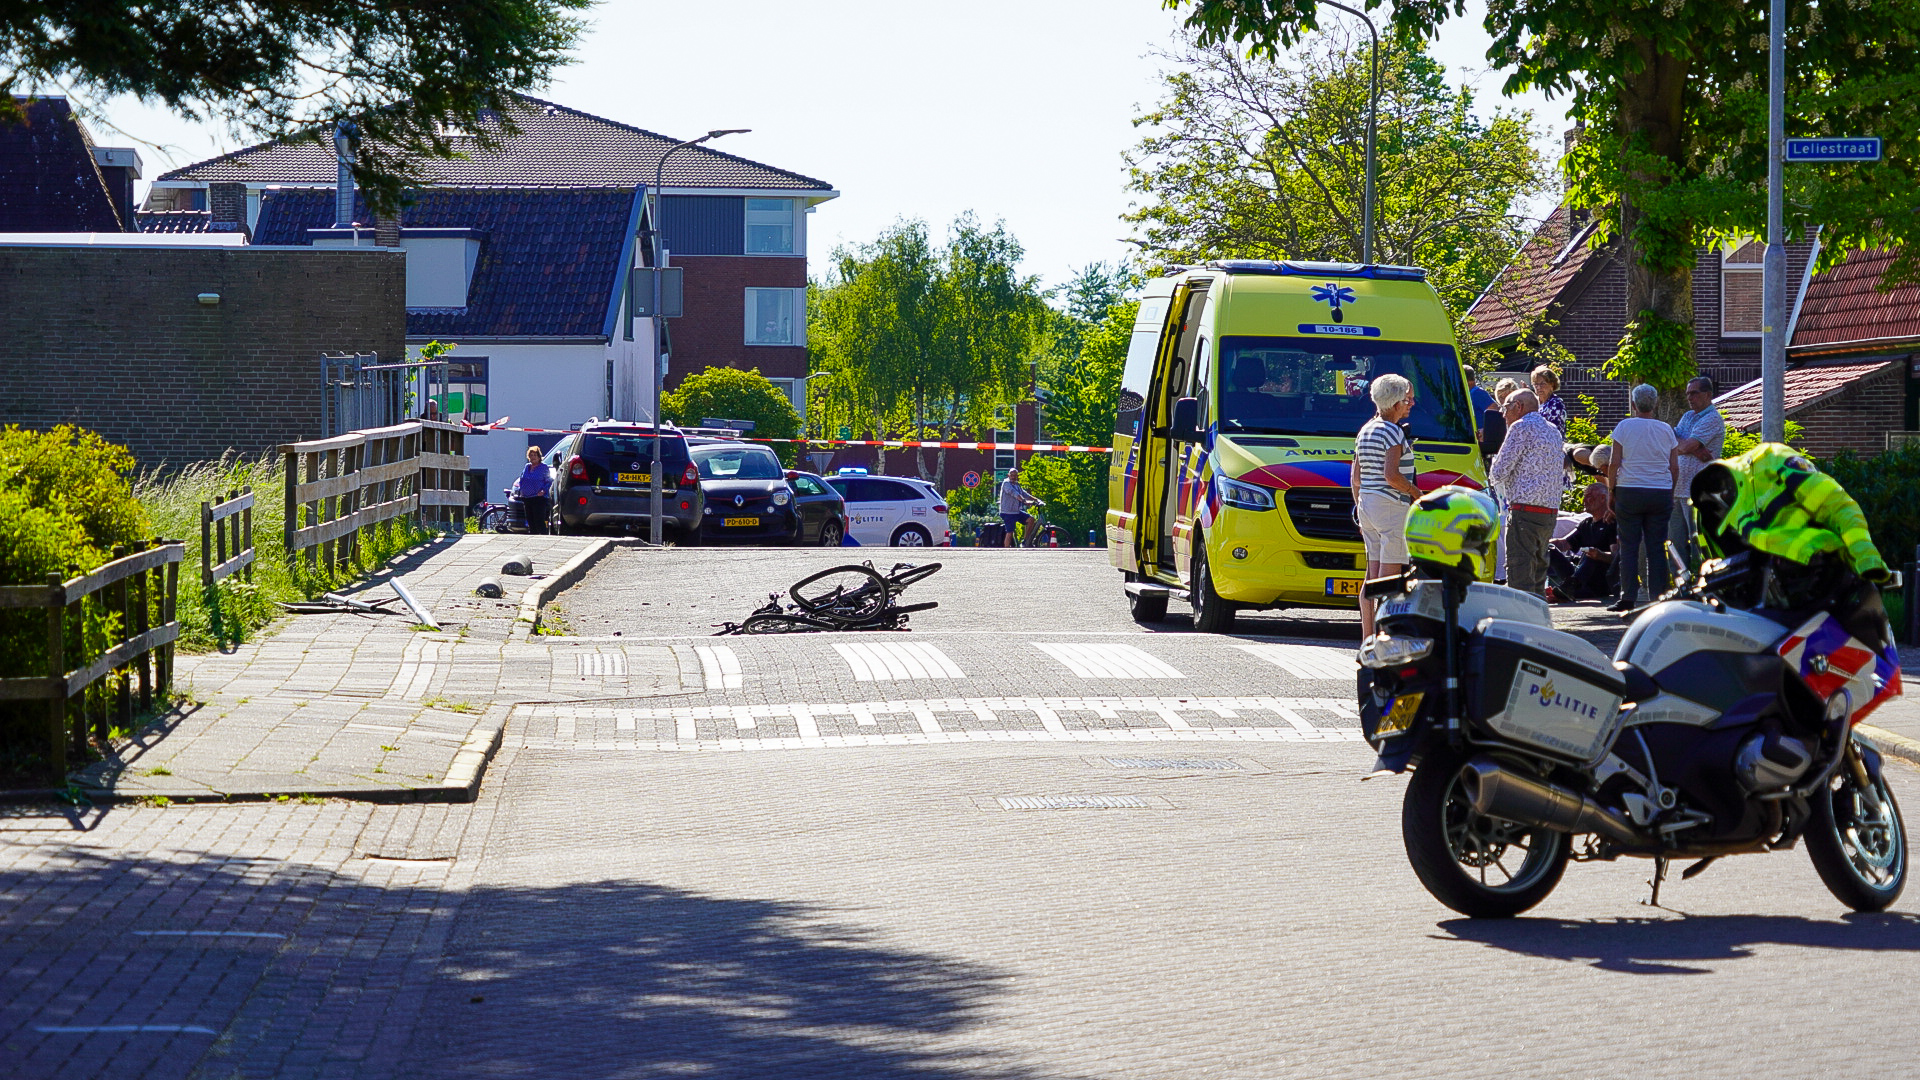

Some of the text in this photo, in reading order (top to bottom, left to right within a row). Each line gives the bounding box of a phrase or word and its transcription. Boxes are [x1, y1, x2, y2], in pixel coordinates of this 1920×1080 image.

[1793, 143, 1873, 154] Leliestraat
[726, 518, 758, 526] PD-610-D
[850, 515, 884, 525] POLITIE
[1340, 580, 1361, 594] R-1
[1529, 682, 1599, 720] POLITIE
